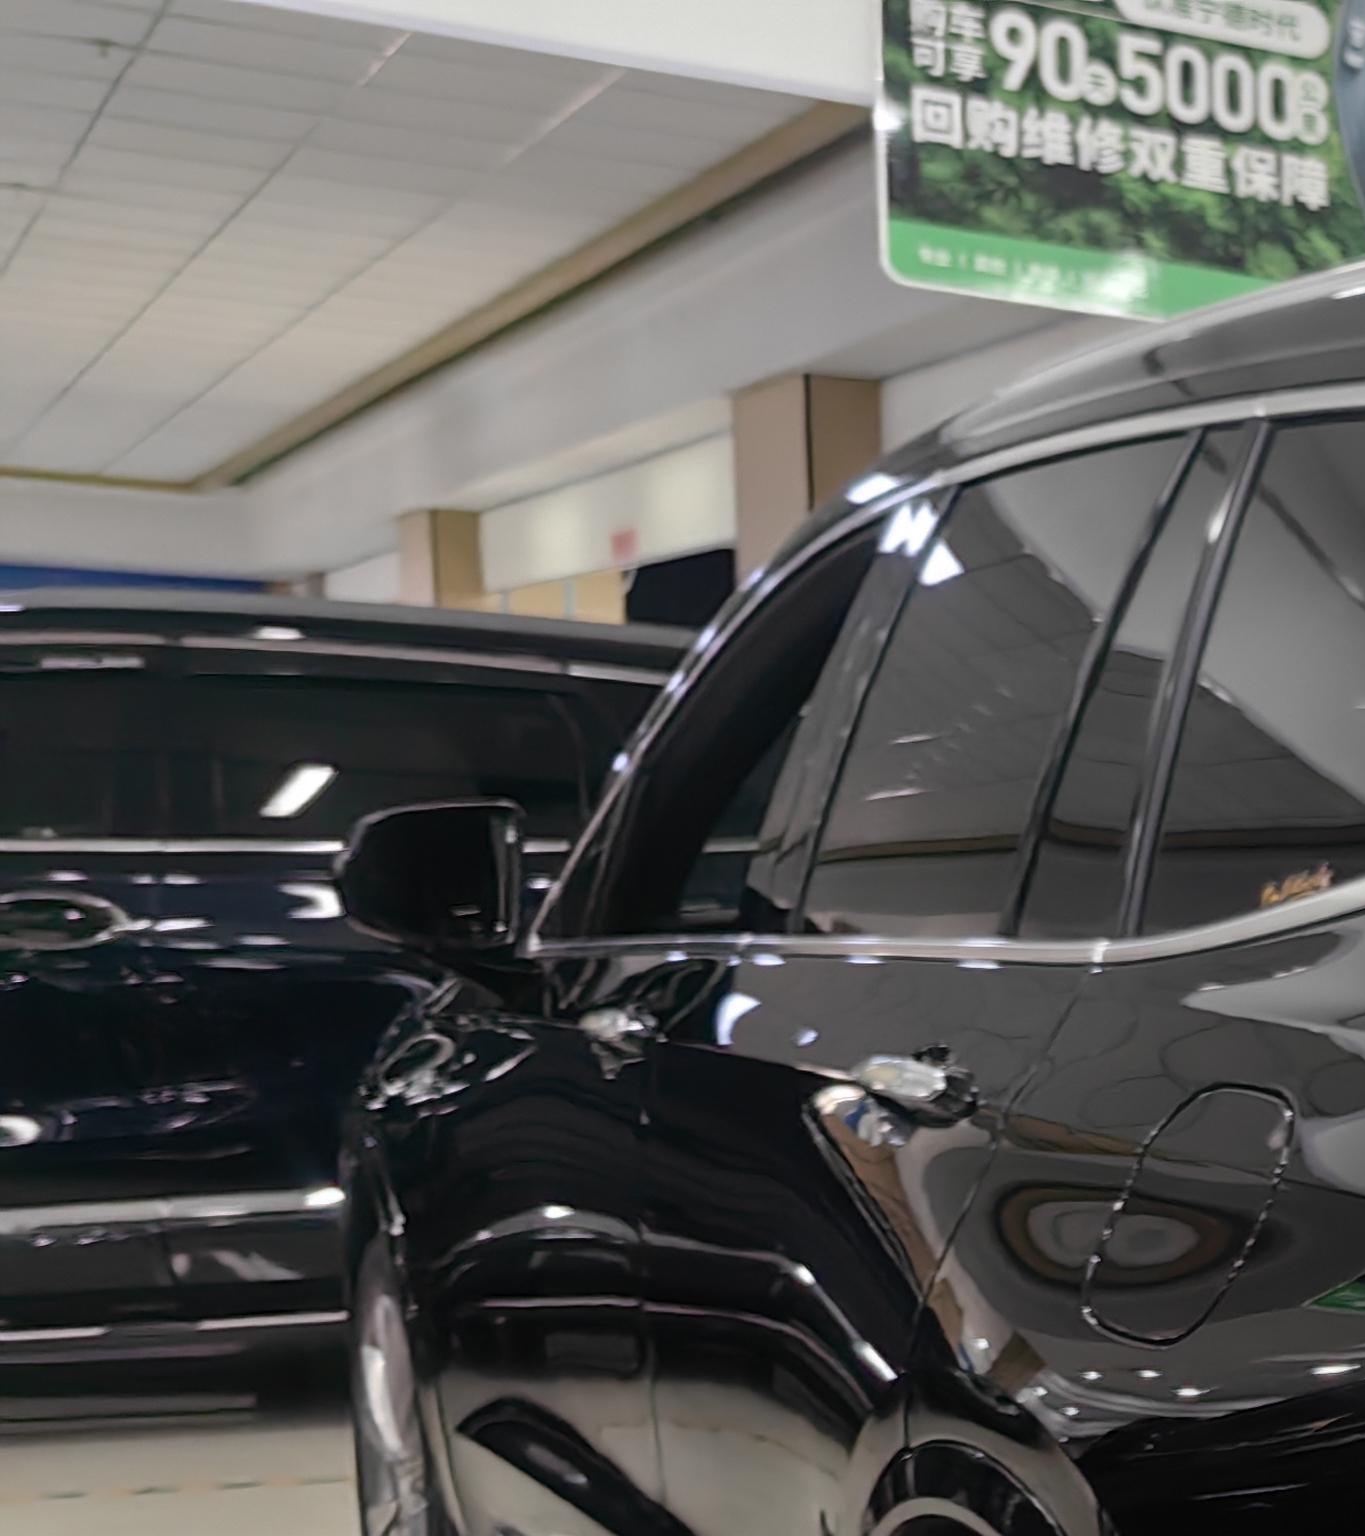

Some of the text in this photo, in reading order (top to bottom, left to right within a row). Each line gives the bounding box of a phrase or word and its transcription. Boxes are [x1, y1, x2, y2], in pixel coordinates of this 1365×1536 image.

[911, 86, 1330, 212] 回购维修双重保障
